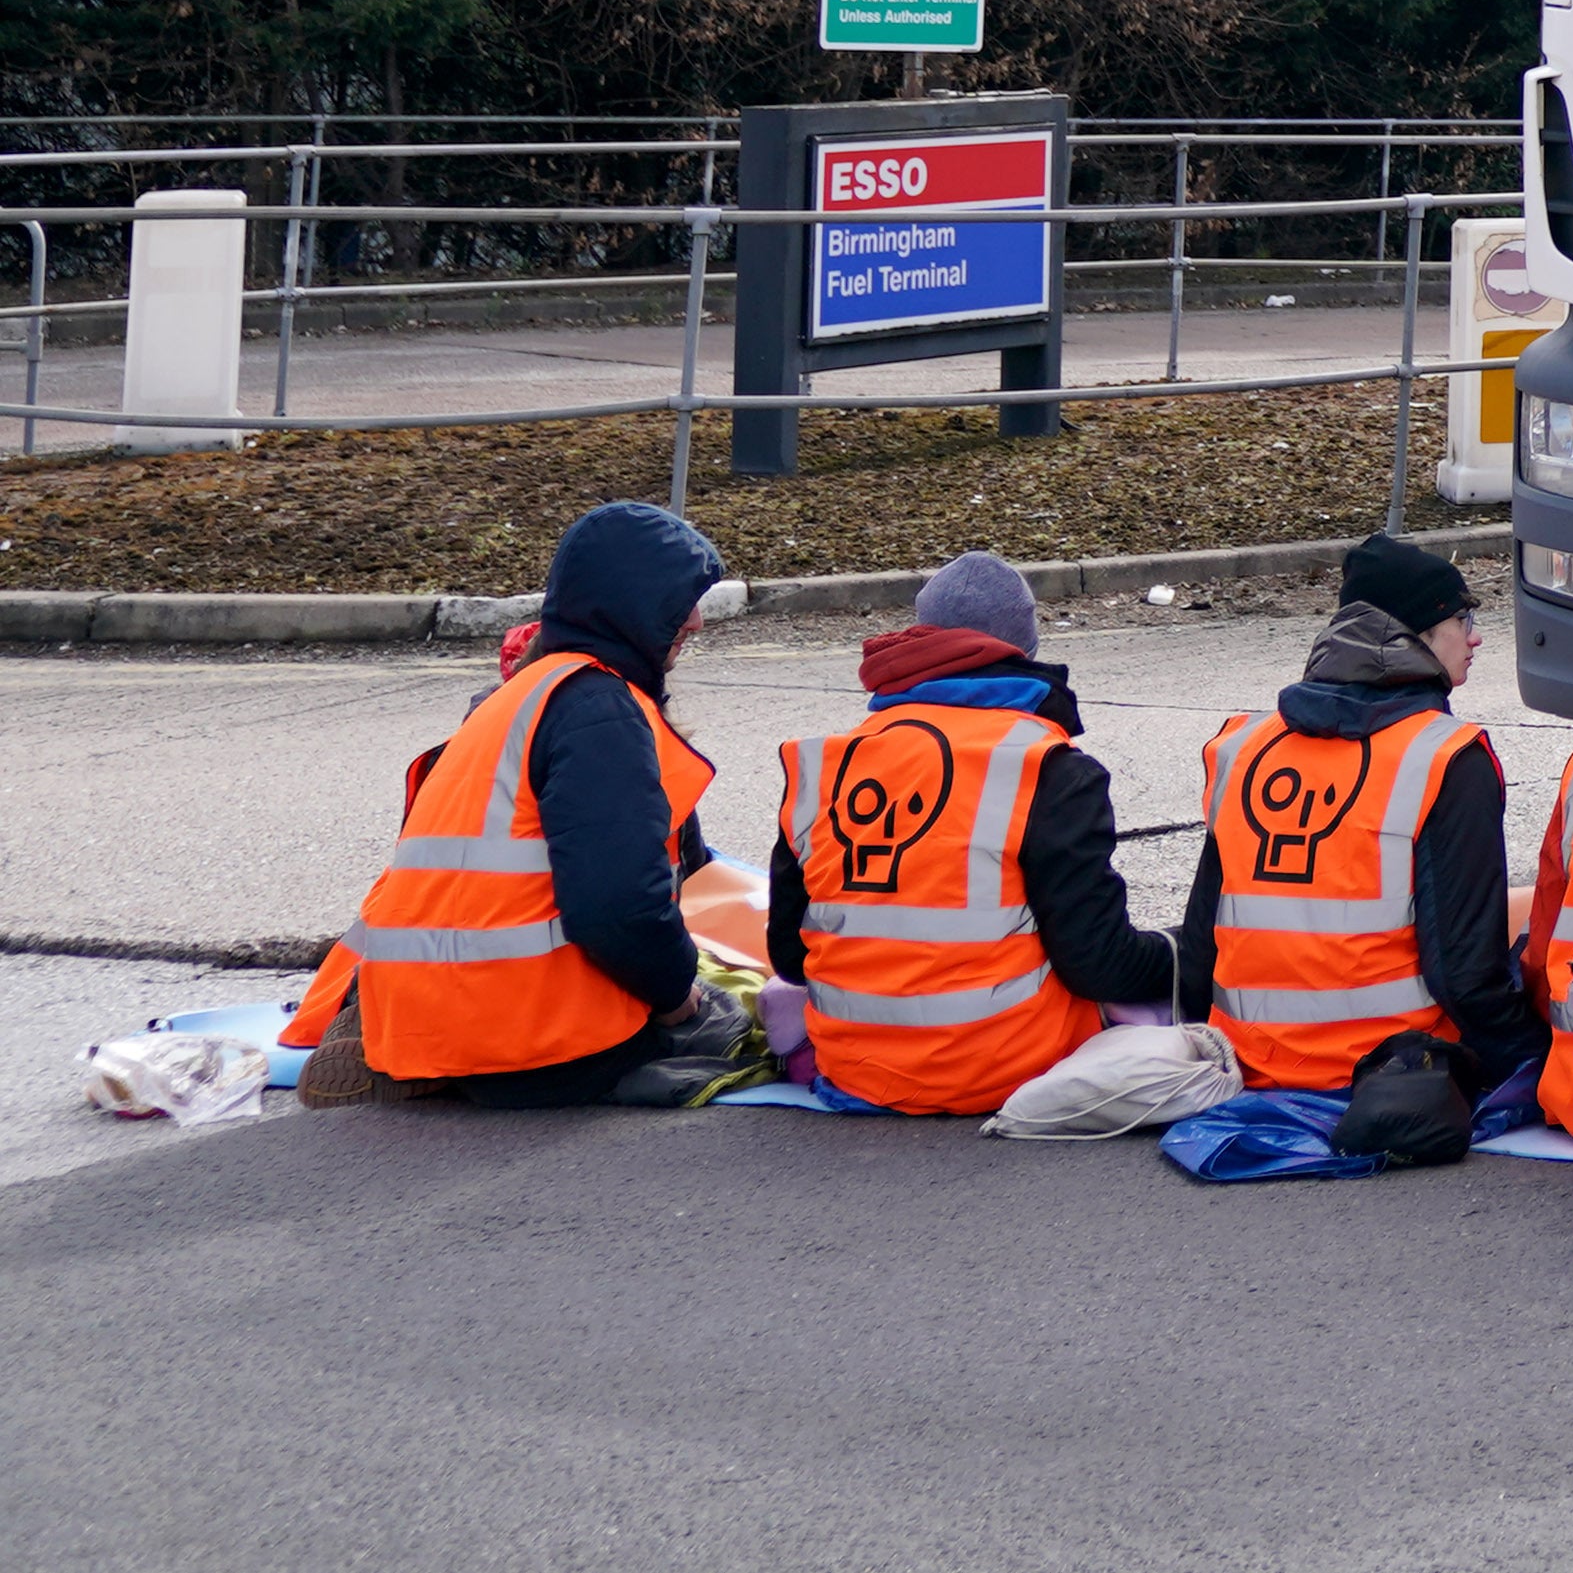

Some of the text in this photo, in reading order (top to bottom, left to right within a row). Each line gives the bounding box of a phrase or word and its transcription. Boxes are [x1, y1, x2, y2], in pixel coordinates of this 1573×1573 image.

[839, 9, 952, 25] Unless Authorised
[831, 157, 928, 201] ESSO
[828, 224, 956, 258] Birmingham
[827, 259, 967, 298] Fuel Terminal
